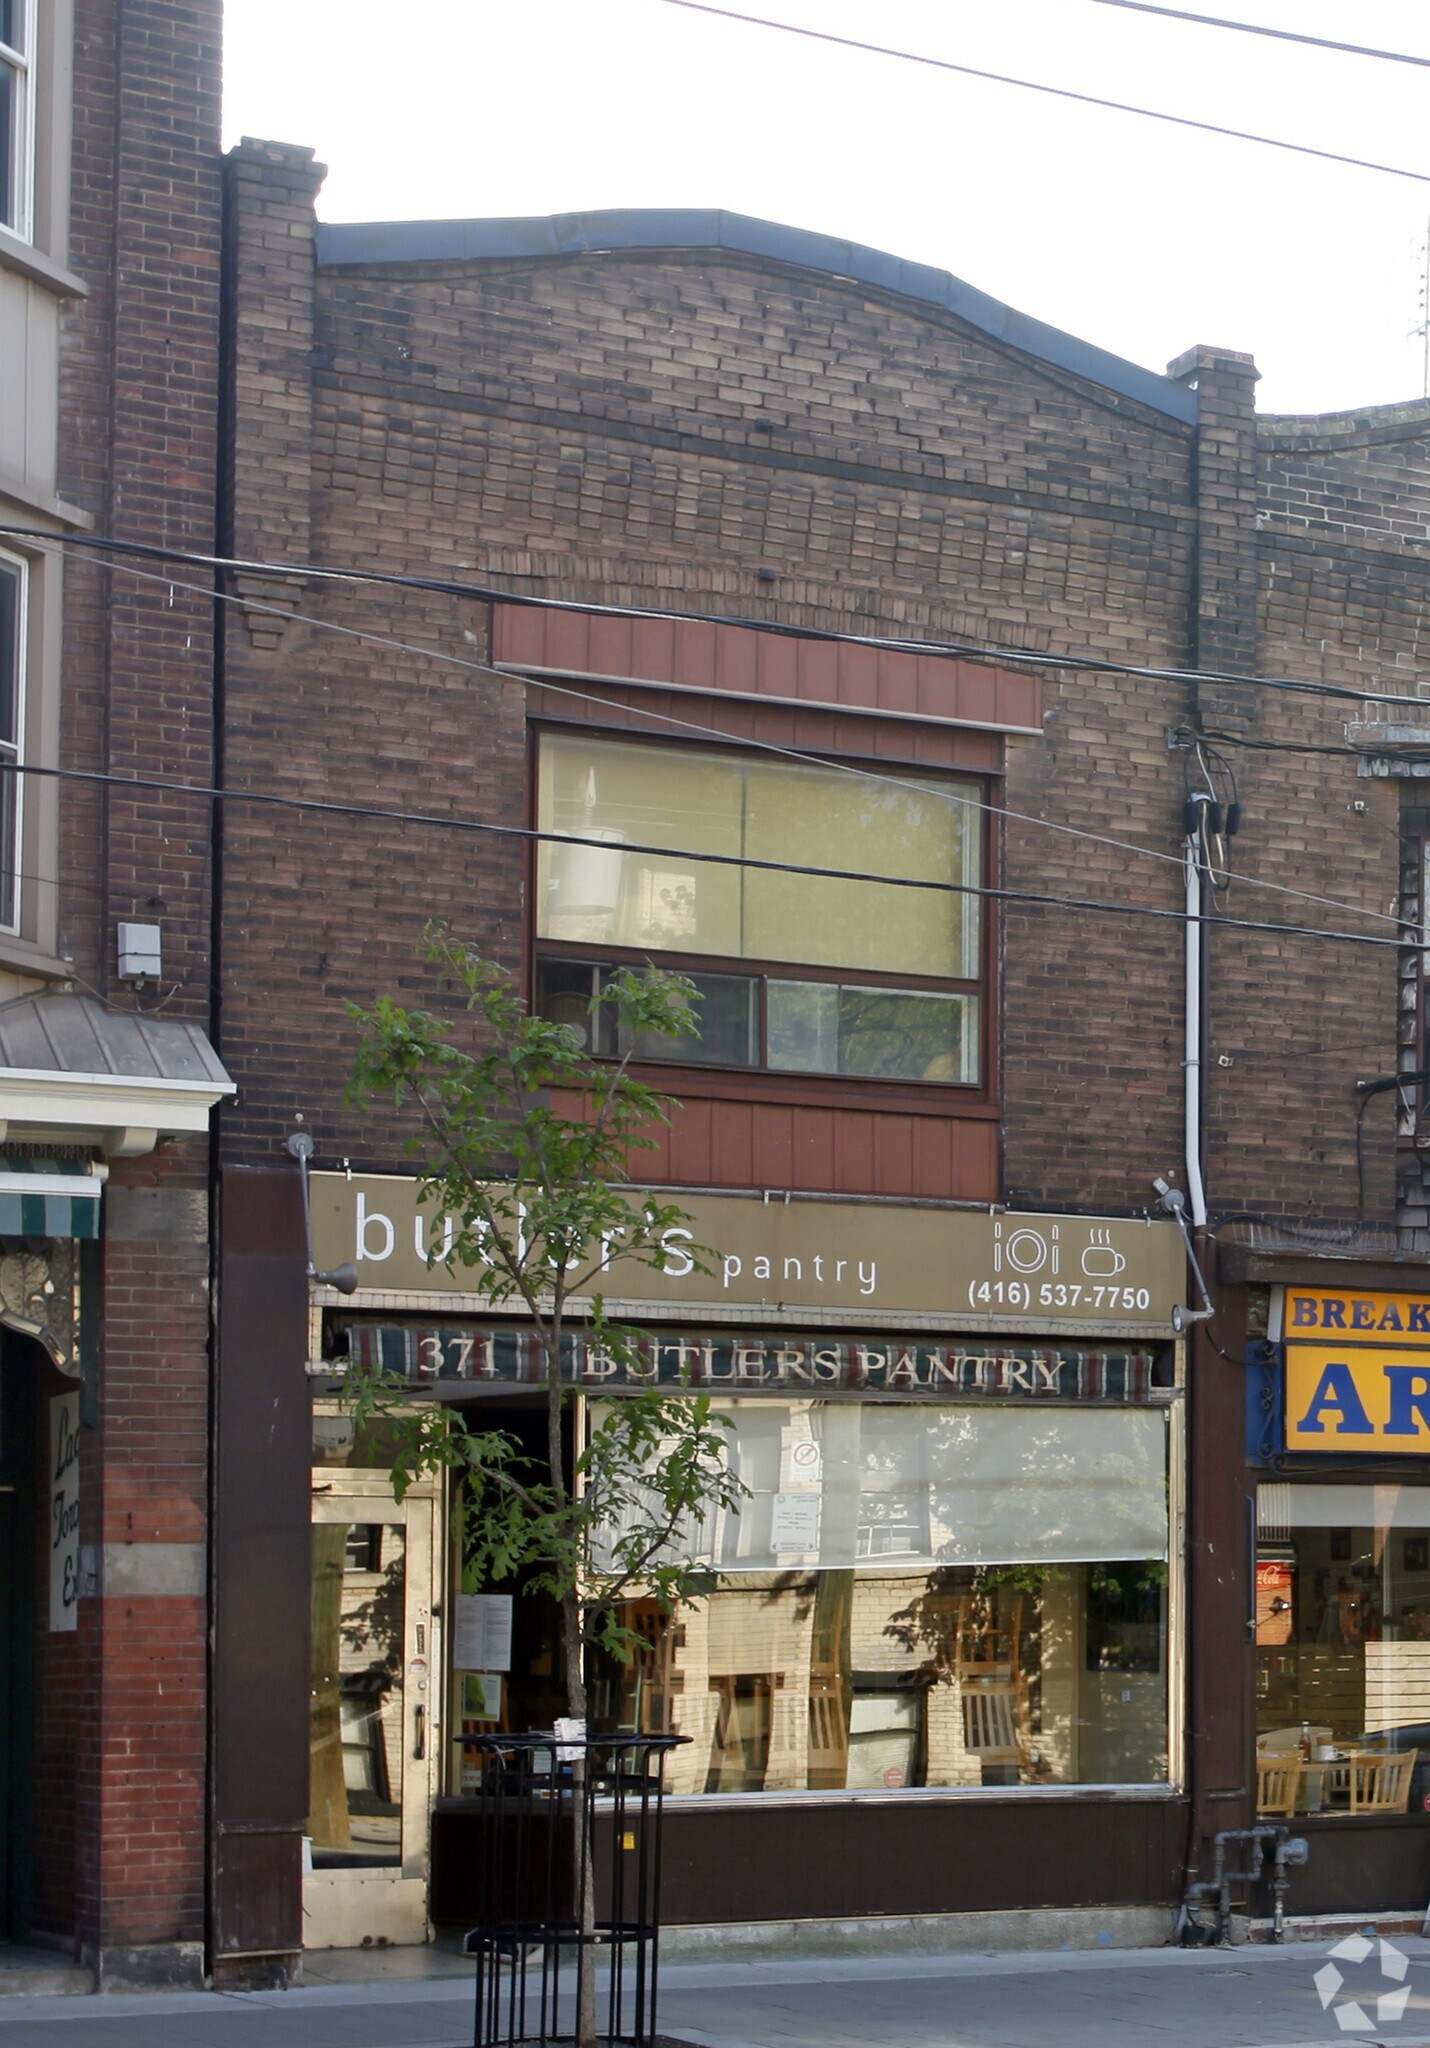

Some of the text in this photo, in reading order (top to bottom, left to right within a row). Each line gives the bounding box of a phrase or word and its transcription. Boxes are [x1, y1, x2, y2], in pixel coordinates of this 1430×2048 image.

[723, 1254, 877, 1295] pantry
[968, 1280, 1150, 1310] (416) 537-7750
[419, 1337, 1067, 1391] 371 BUTLERS PANTRY
